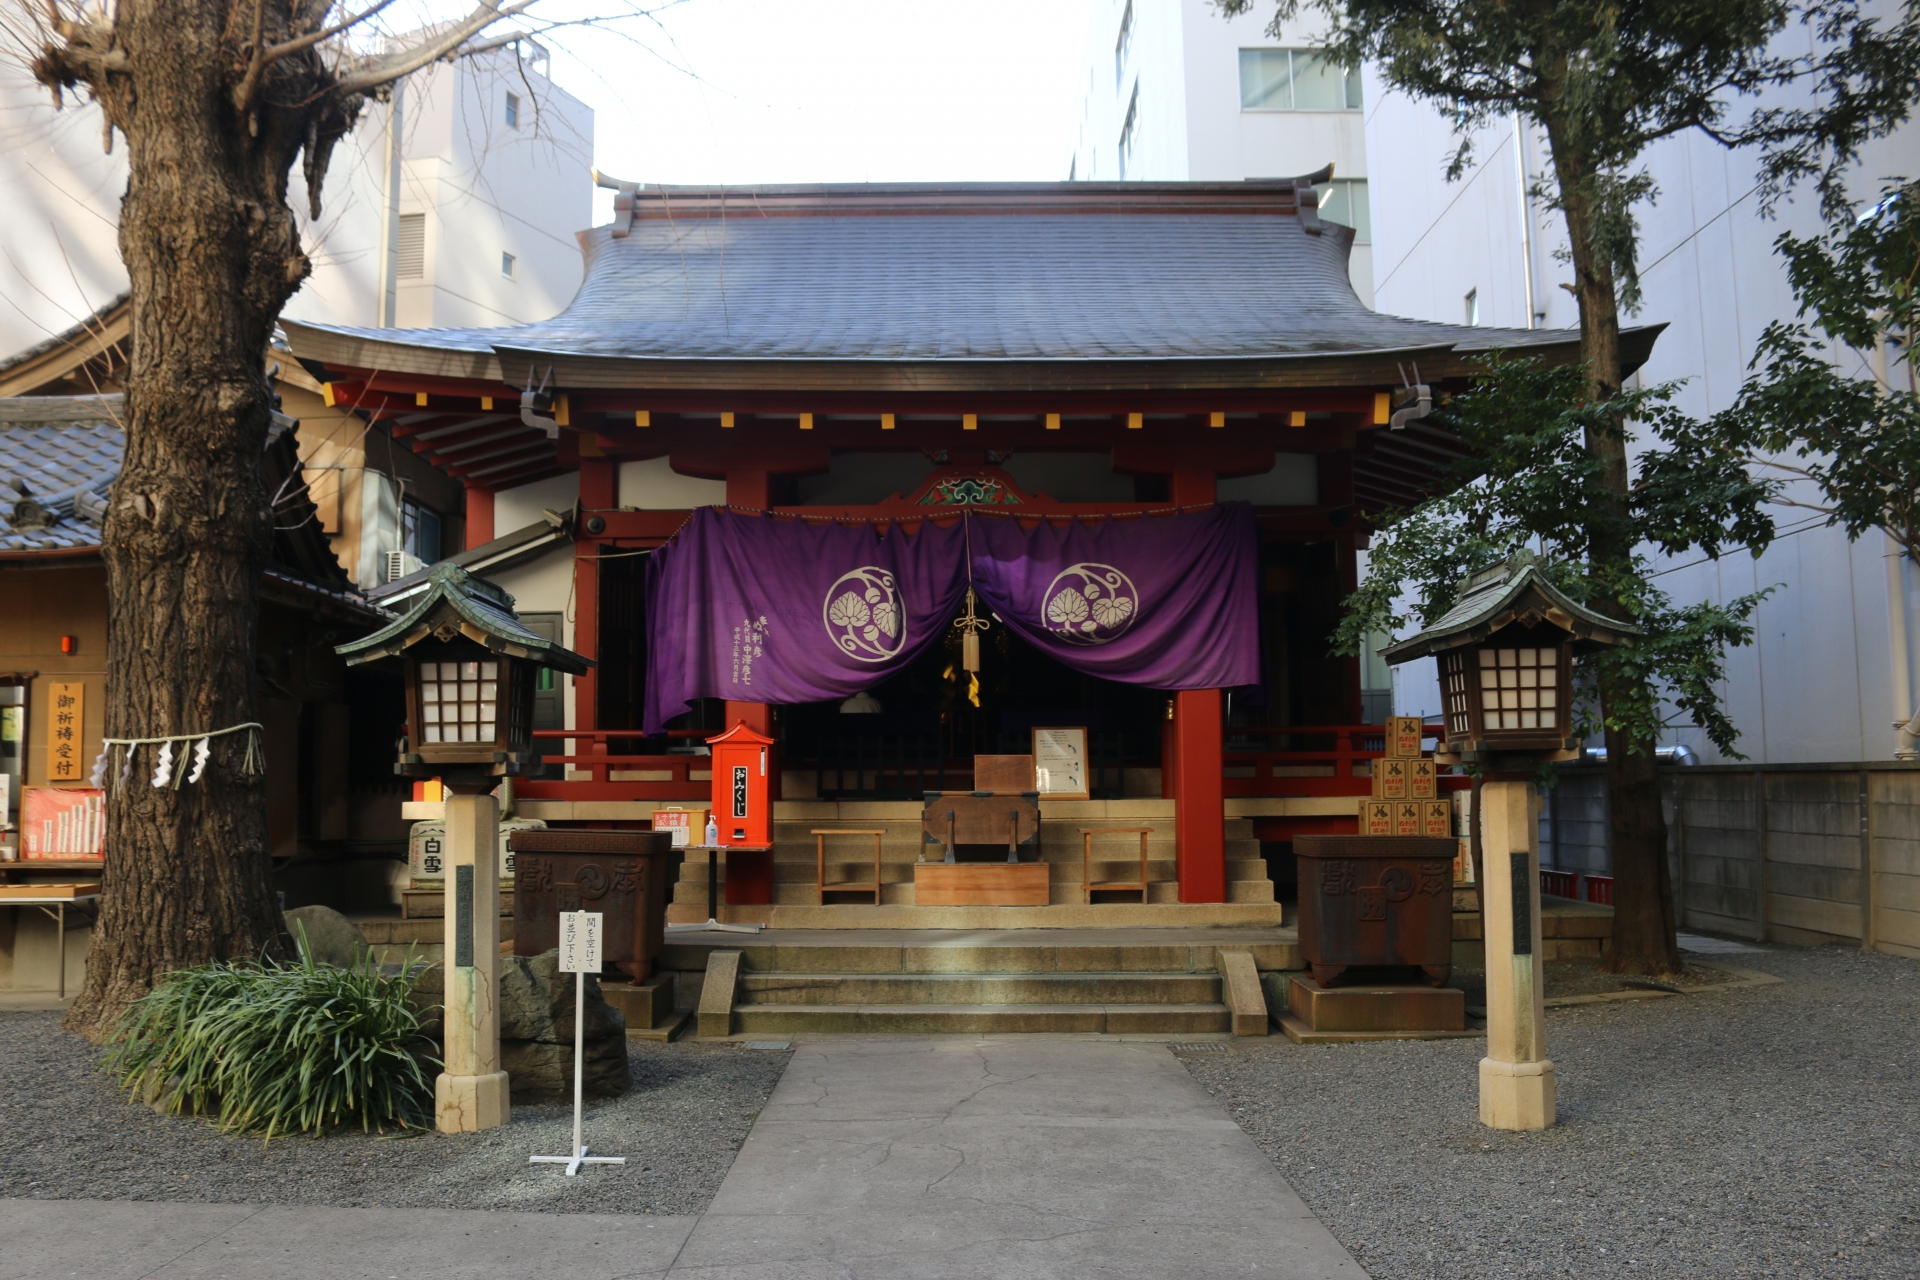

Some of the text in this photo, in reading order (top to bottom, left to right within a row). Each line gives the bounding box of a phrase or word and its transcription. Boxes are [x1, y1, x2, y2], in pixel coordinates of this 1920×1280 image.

[735, 769, 746, 816] おみくじ
[424, 837, 442, 873] 白雪
[566, 914, 576, 970] お並び下さい
[586, 917, 596, 968] 間を空けて
